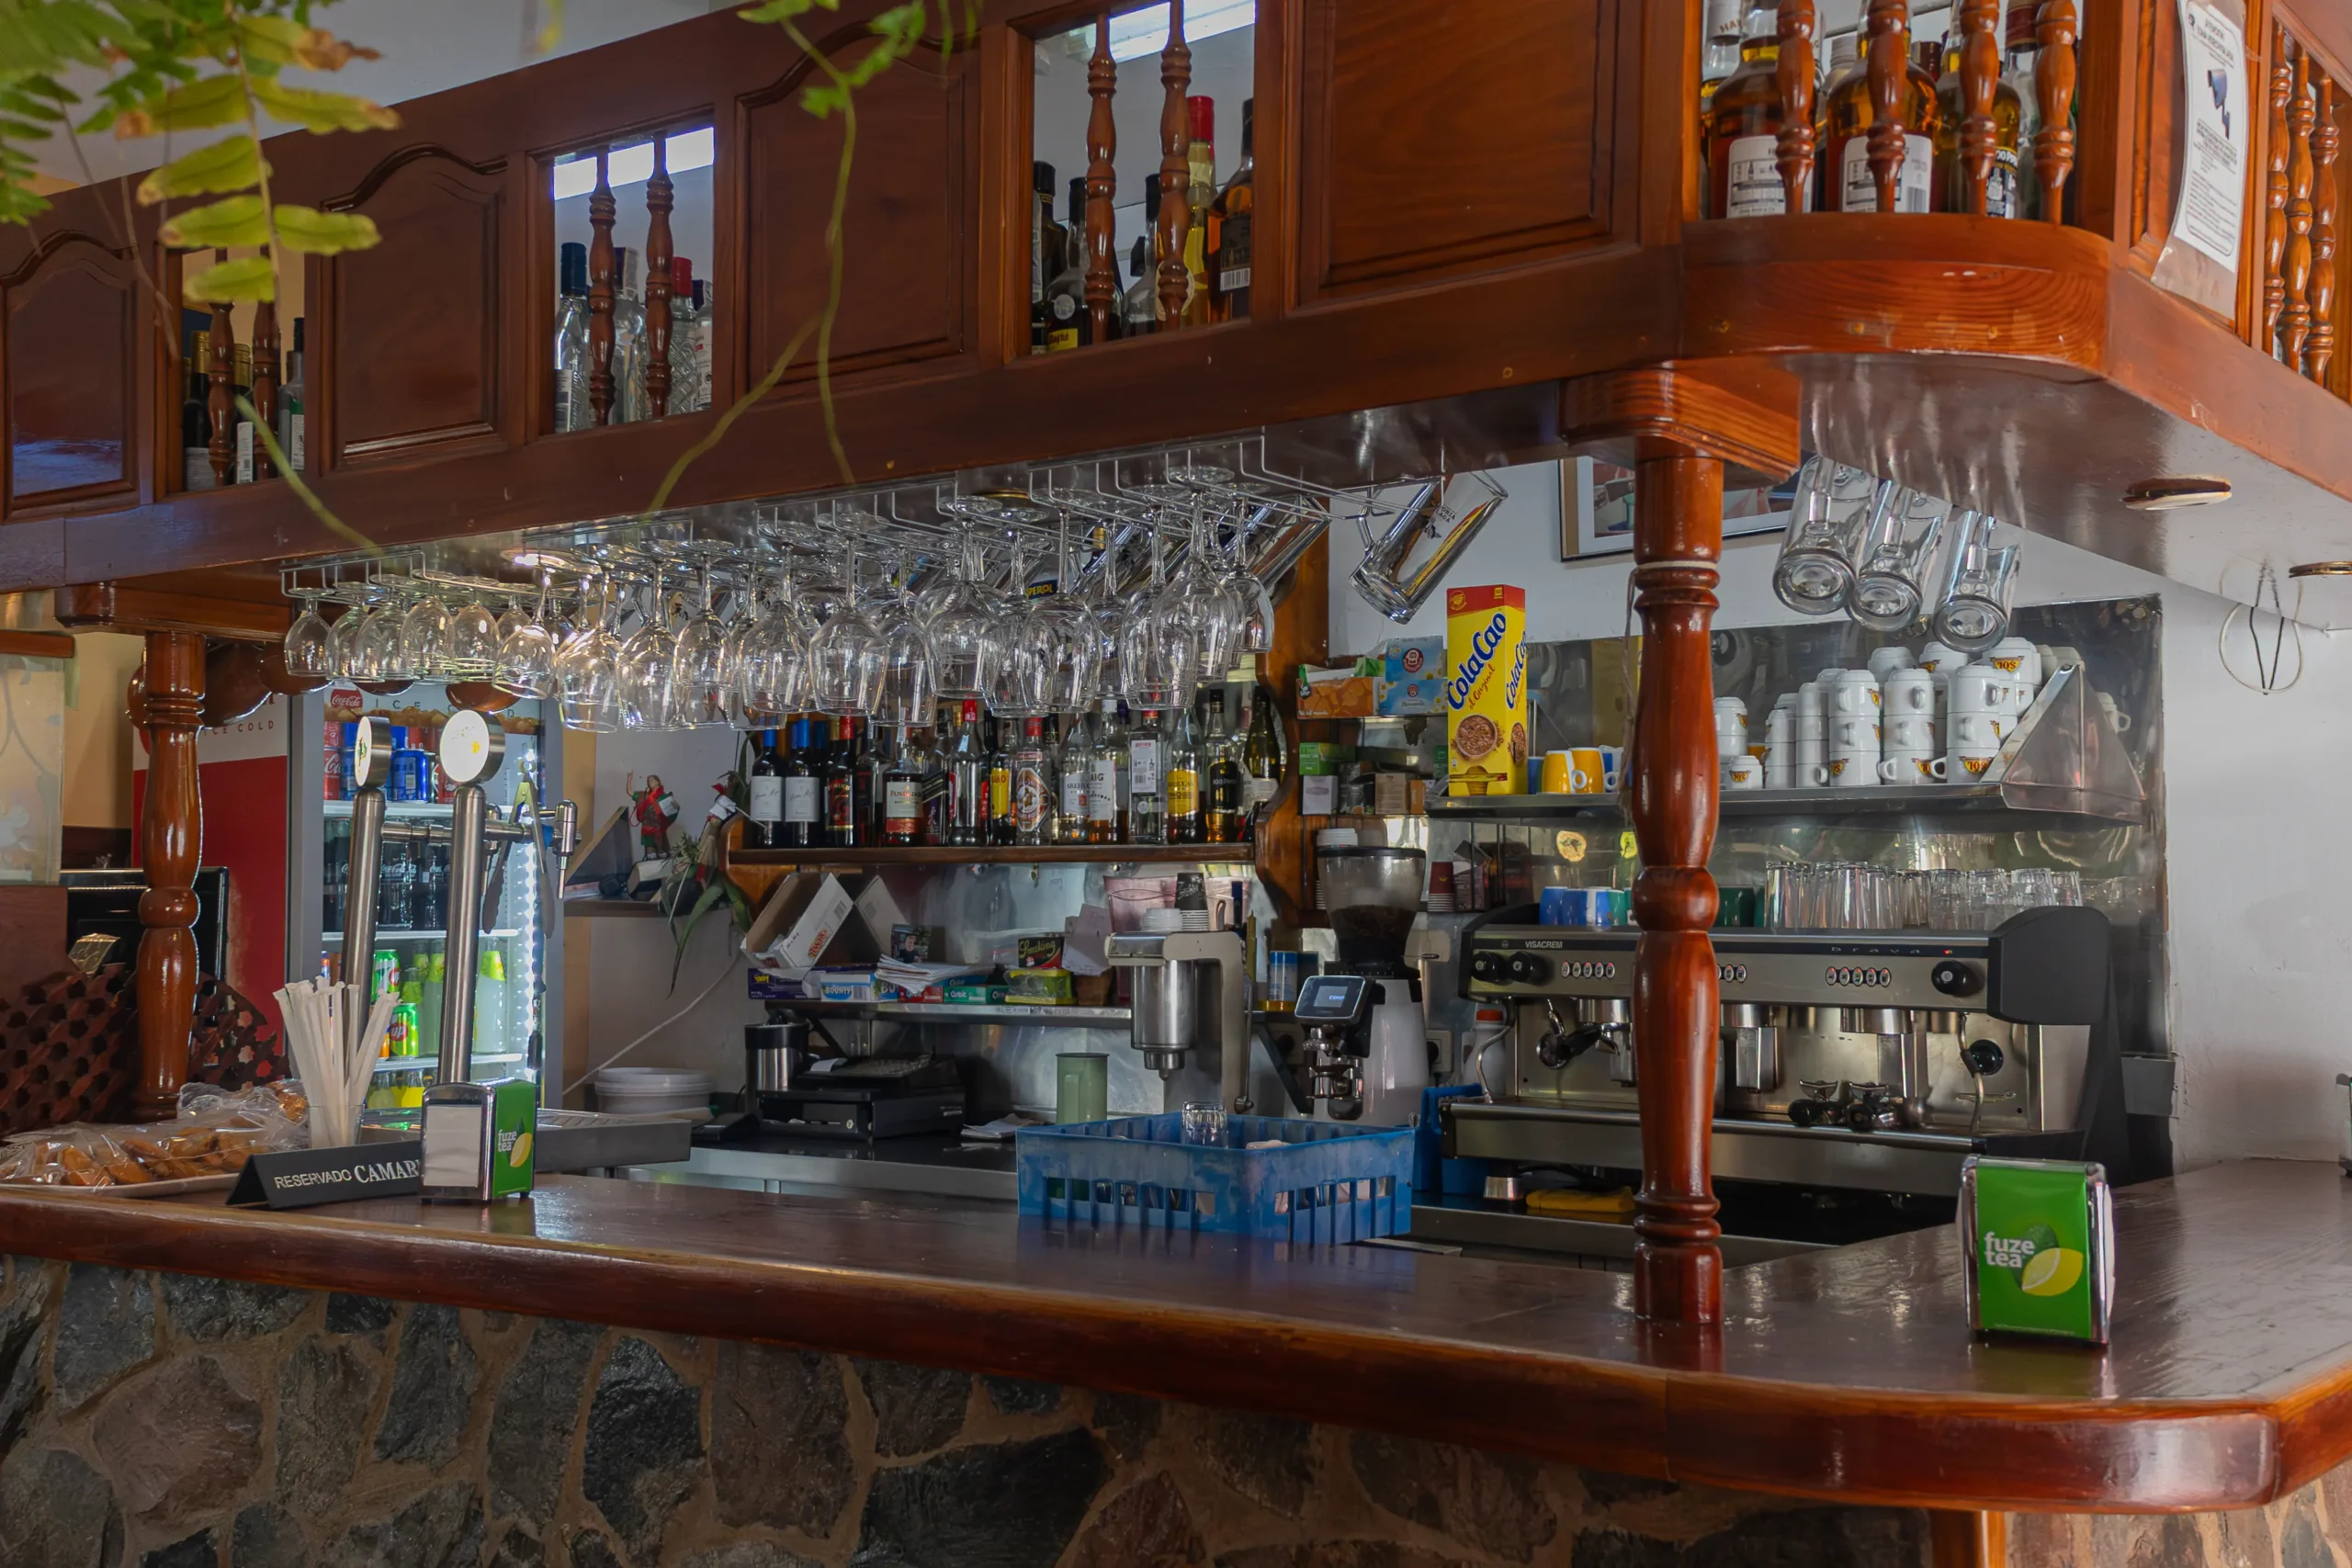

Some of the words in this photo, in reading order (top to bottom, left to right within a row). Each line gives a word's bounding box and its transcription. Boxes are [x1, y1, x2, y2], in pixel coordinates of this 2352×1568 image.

[1447, 613, 1506, 710] ColaCao
[332, 694, 361, 707] Coca-Cola
[237, 720, 274, 732] COLD
[1019, 940, 1056, 959] Smoking
[1525, 941, 1563, 949] VISACREM
[825, 986, 852, 995] BOUNTY
[950, 990, 967, 998] Orbit
[497, 1129, 517, 1142] fuze
[497, 1140, 514, 1152] tea
[274, 1168, 353, 1190] RESERVADO
[354, 1158, 420, 1184] CAMAR
[1984, 1231, 2035, 1255] fuze
[1984, 1250, 2023, 1268] tea
